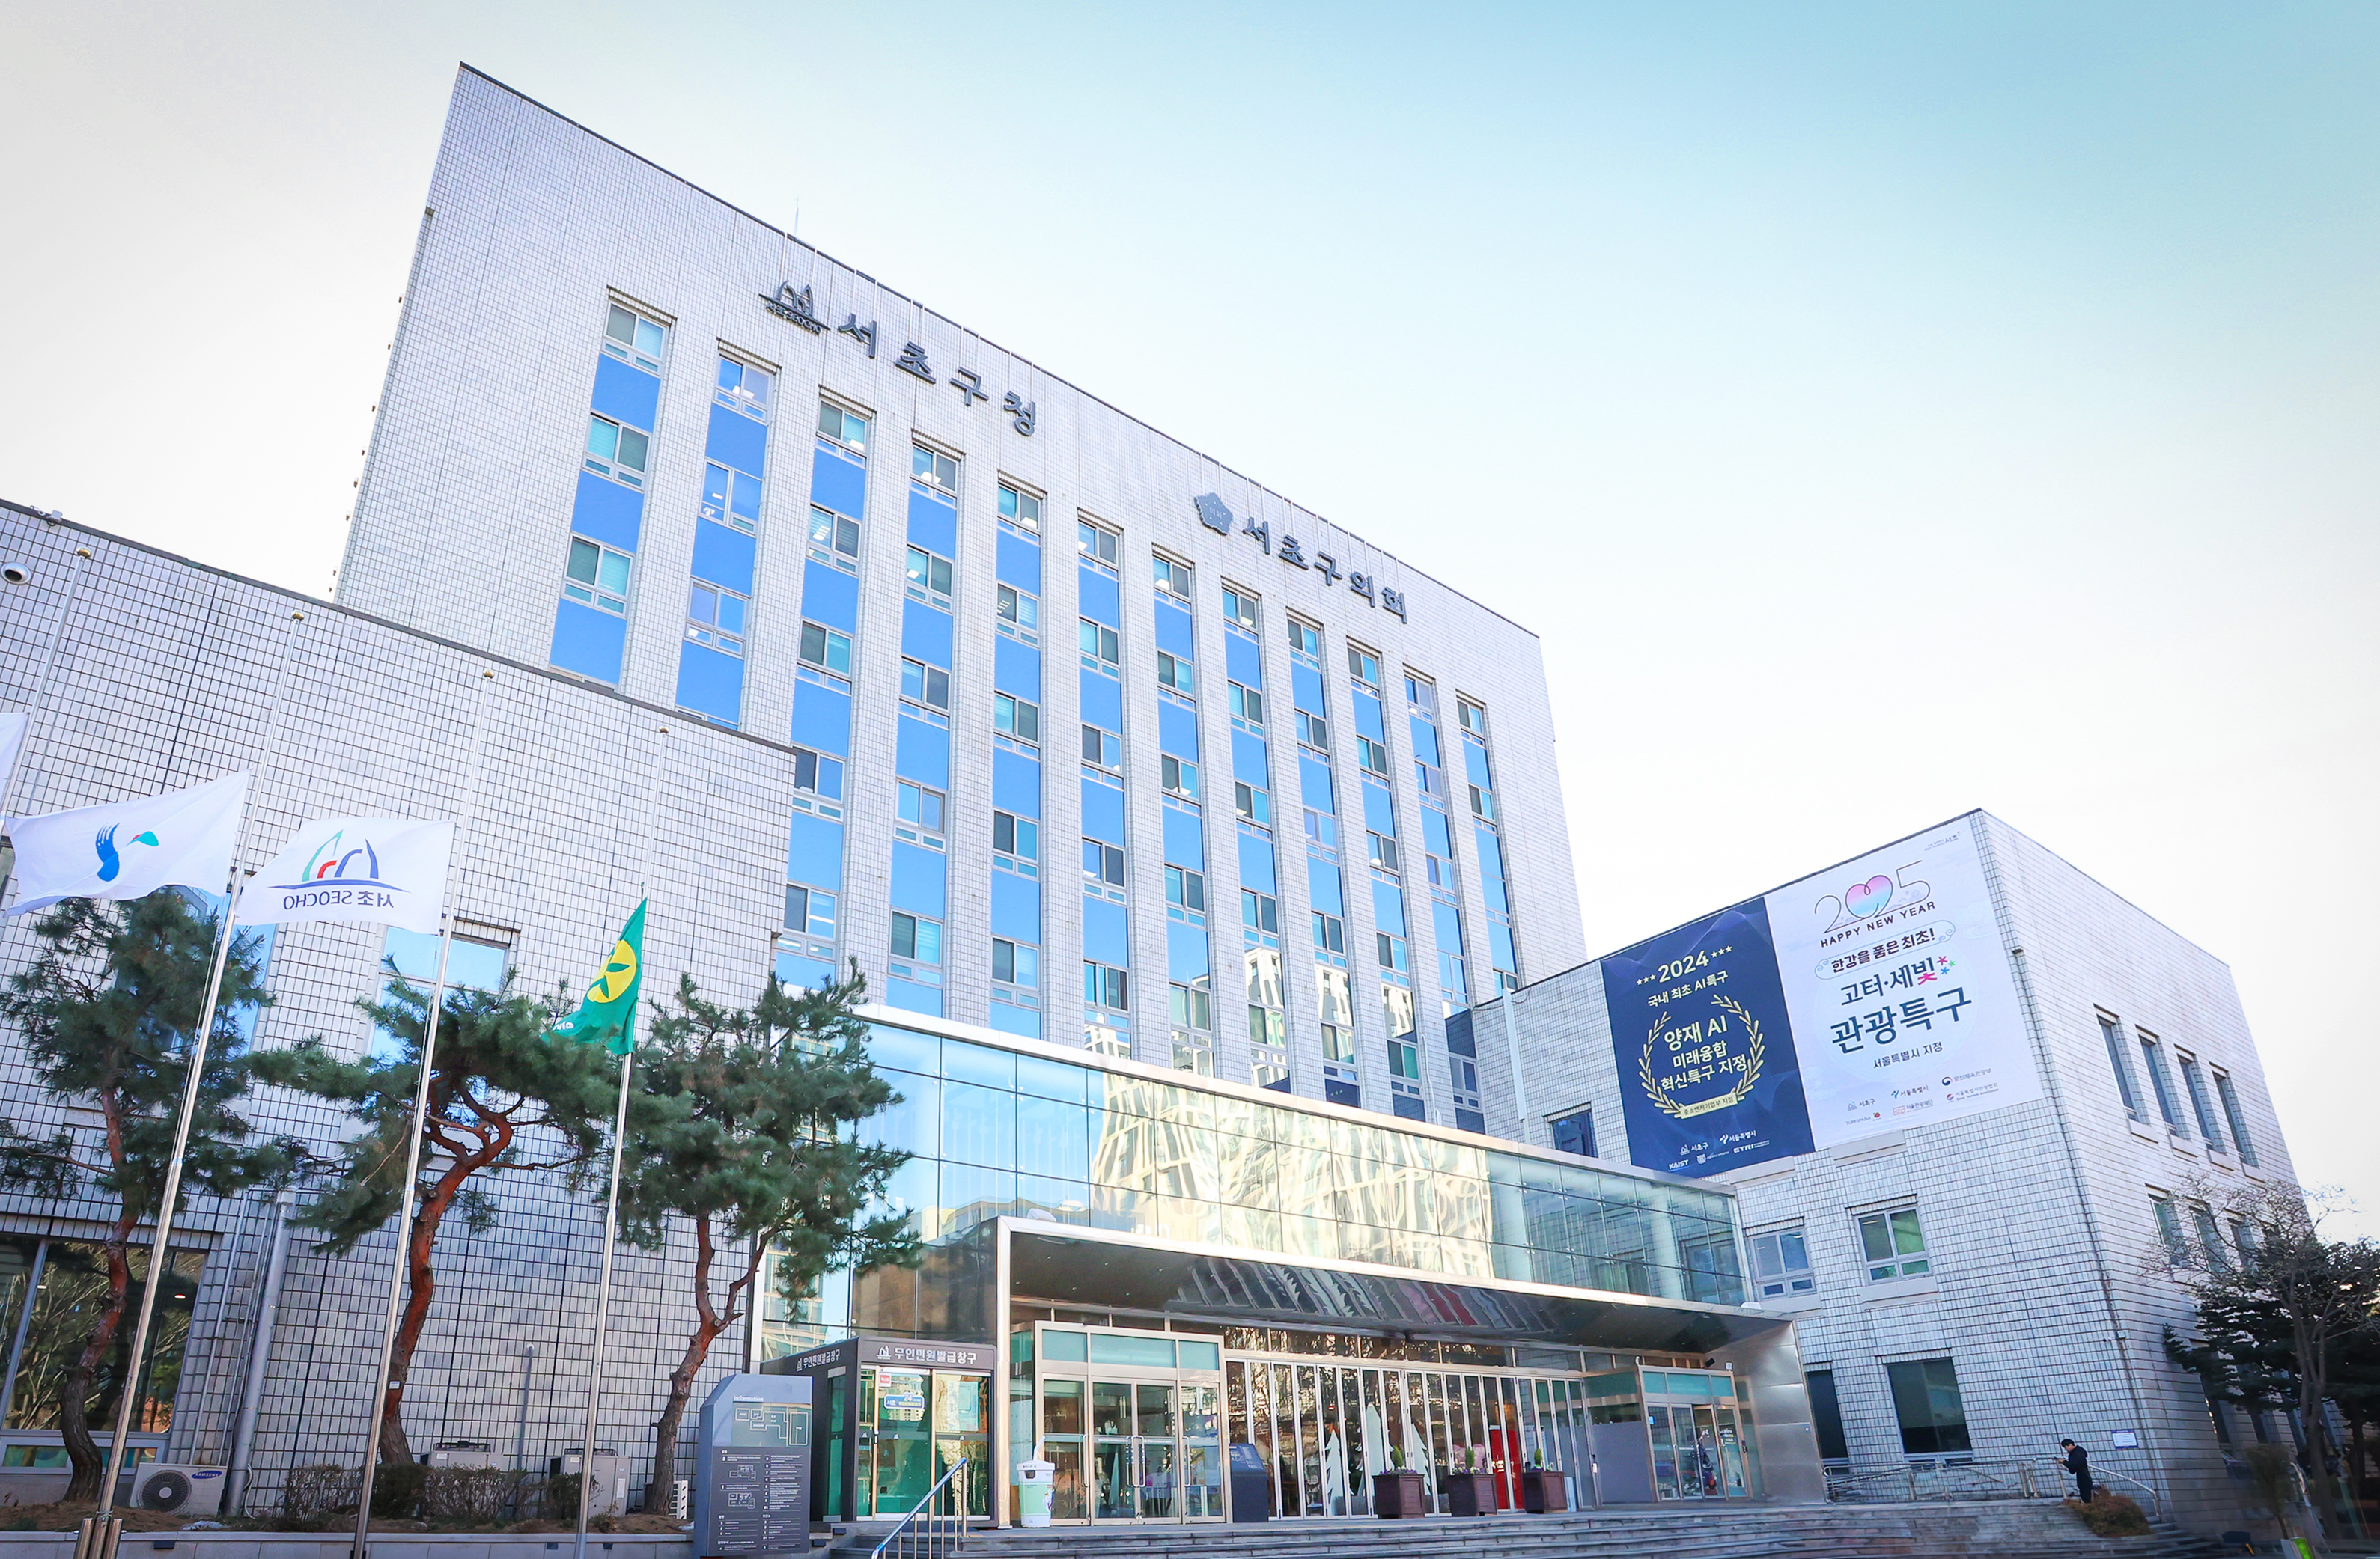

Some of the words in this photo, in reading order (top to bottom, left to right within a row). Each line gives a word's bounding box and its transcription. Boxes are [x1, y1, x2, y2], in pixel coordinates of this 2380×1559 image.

[838, 313, 1036, 437] 서초구청
[1242, 516, 1407, 624] 서초구의회
[1820, 926, 1860, 948] HAPPY
[1867, 915, 1894, 932] NEW
[1899, 901, 1936, 920] YEAR
[1657, 950, 1710, 983] 2024
[1831, 949, 1871, 974] 한강을
[1873, 939, 1899, 960] 품은
[1901, 927, 1935, 949] 최초!
[1648, 991, 1670, 1007] 국내
[1671, 984, 1693, 1000] 최초
[1694, 970, 1729, 992] AI특구
[1664, 1021, 1702, 1052] 양재
[1707, 1015, 1728, 1037] AI
[1830, 986, 1972, 1054] 관광특구
[1660, 1064, 1716, 1092] 혁신특구
[1719, 1054, 1749, 1075] 지정
[1672, 1042, 1728, 1069] 미래융합
[1873, 1046, 1920, 1069] 서울특별시
[1923, 1042, 1944, 1055] 지정
[1668, 1159, 1689, 1169] KAIST
[894, 1347, 976, 1365] 무인민원발급창구
